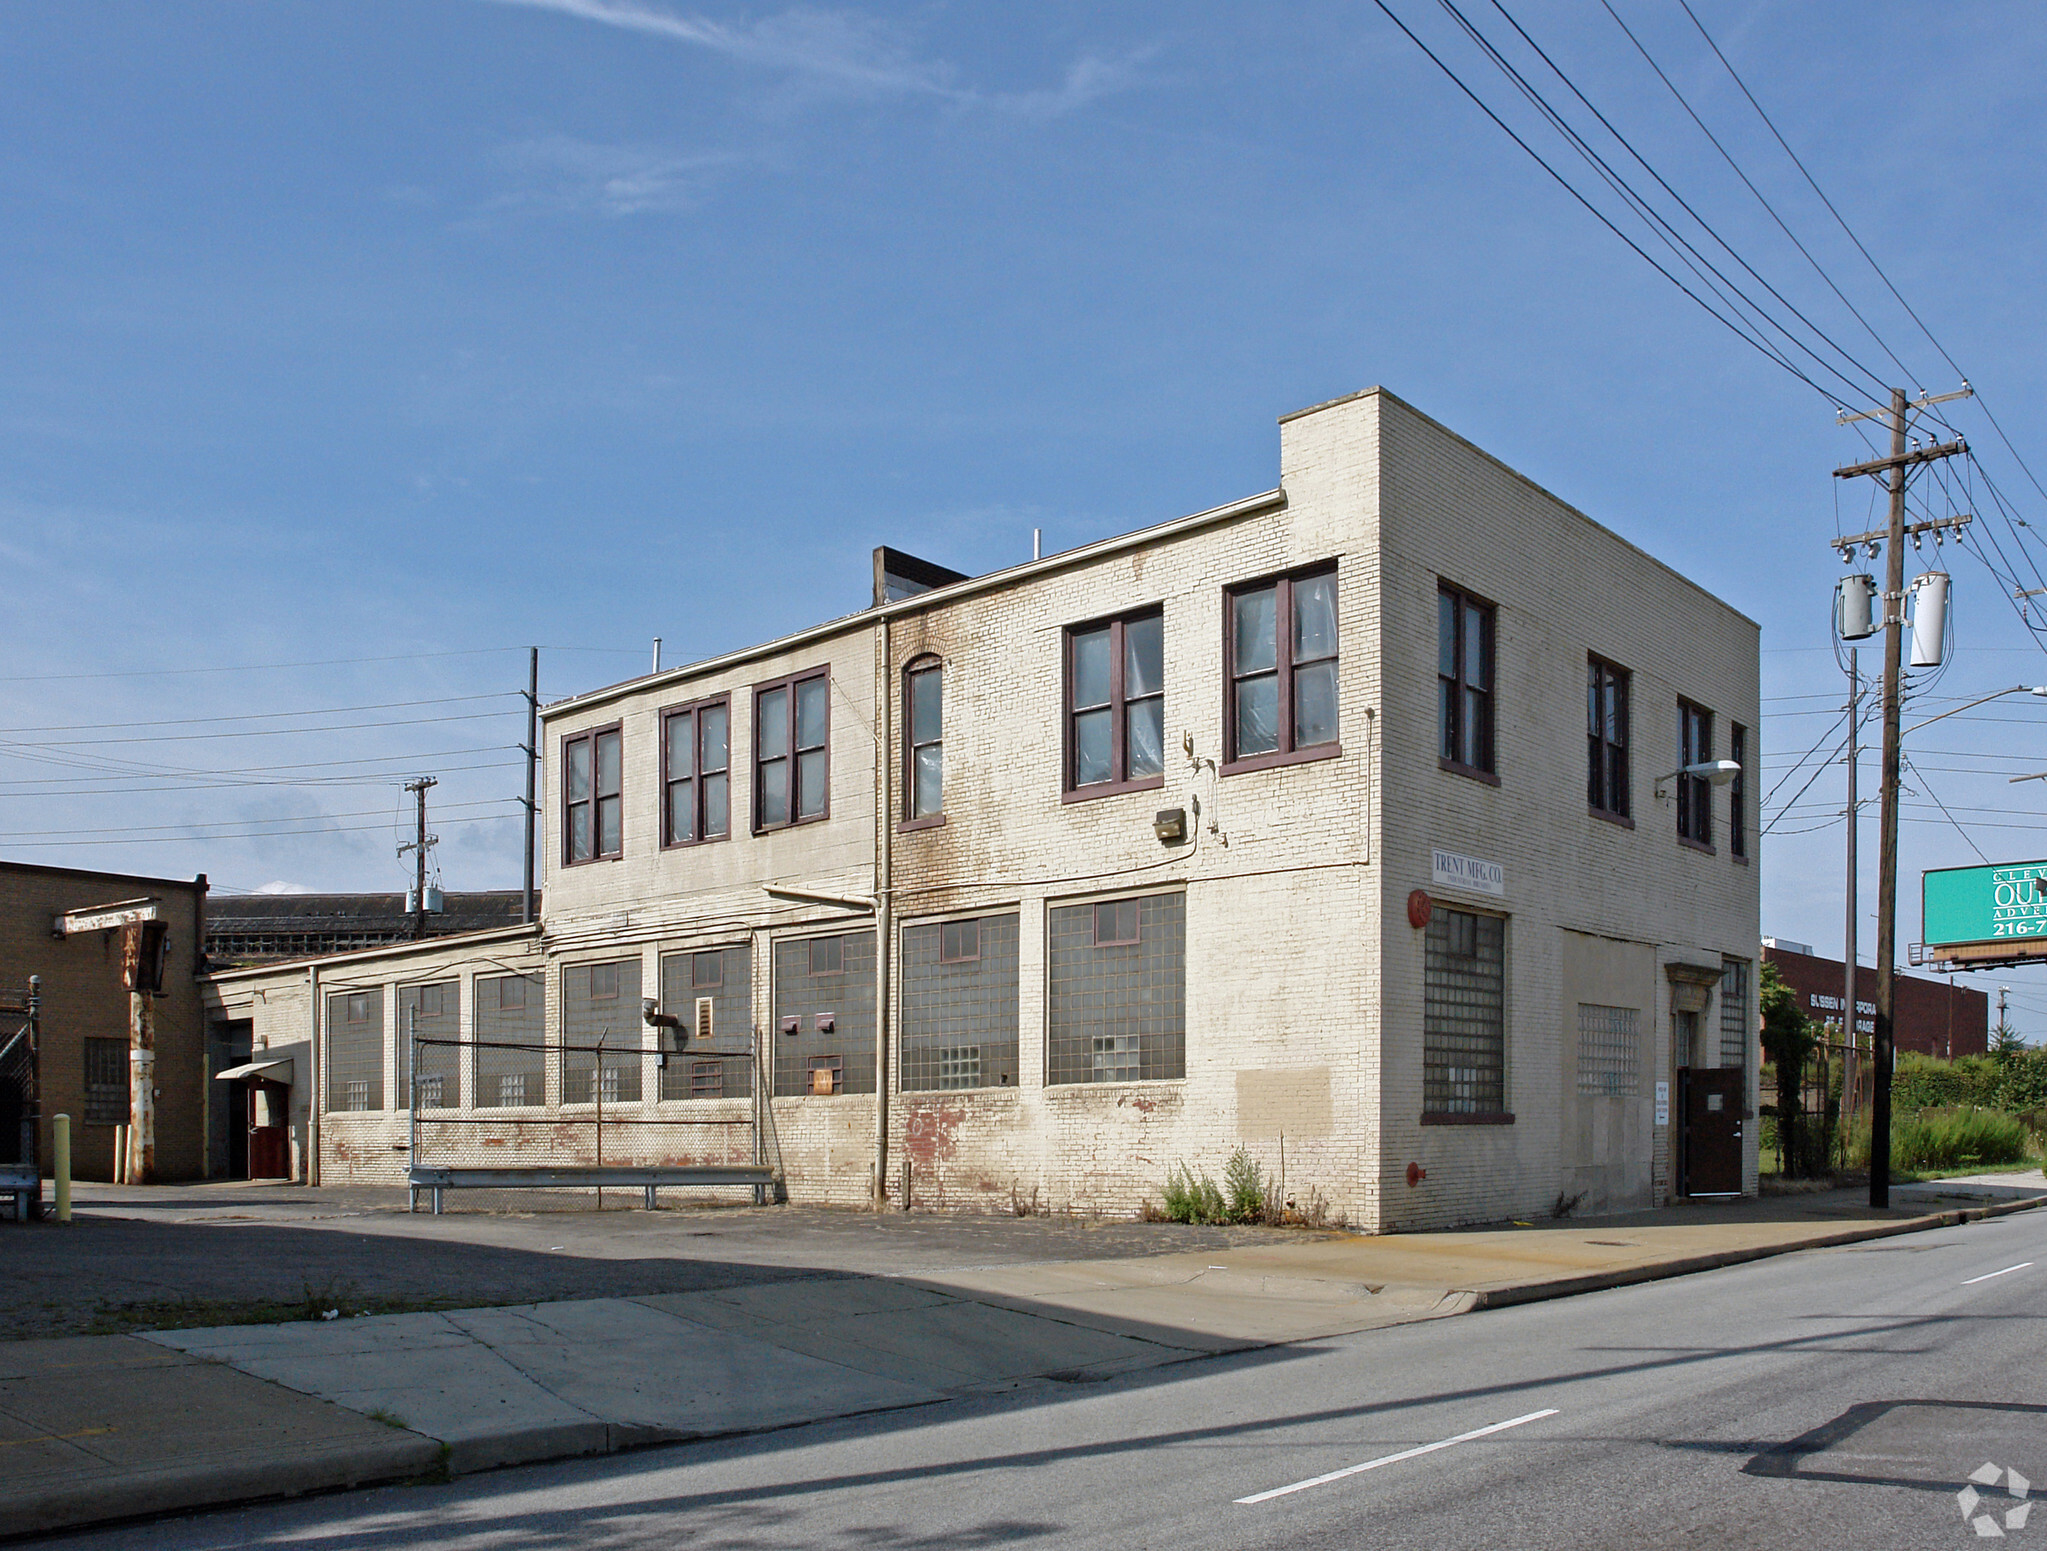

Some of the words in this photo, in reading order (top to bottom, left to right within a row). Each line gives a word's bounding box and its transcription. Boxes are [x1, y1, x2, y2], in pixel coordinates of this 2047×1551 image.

[1435, 853, 1464, 875] TRENT
[1467, 861, 1487, 880] MFG.
[1489, 866, 1502, 883] CO.
[1993, 906, 2047, 918] ADVE
[1993, 921, 2047, 936] 216-7
